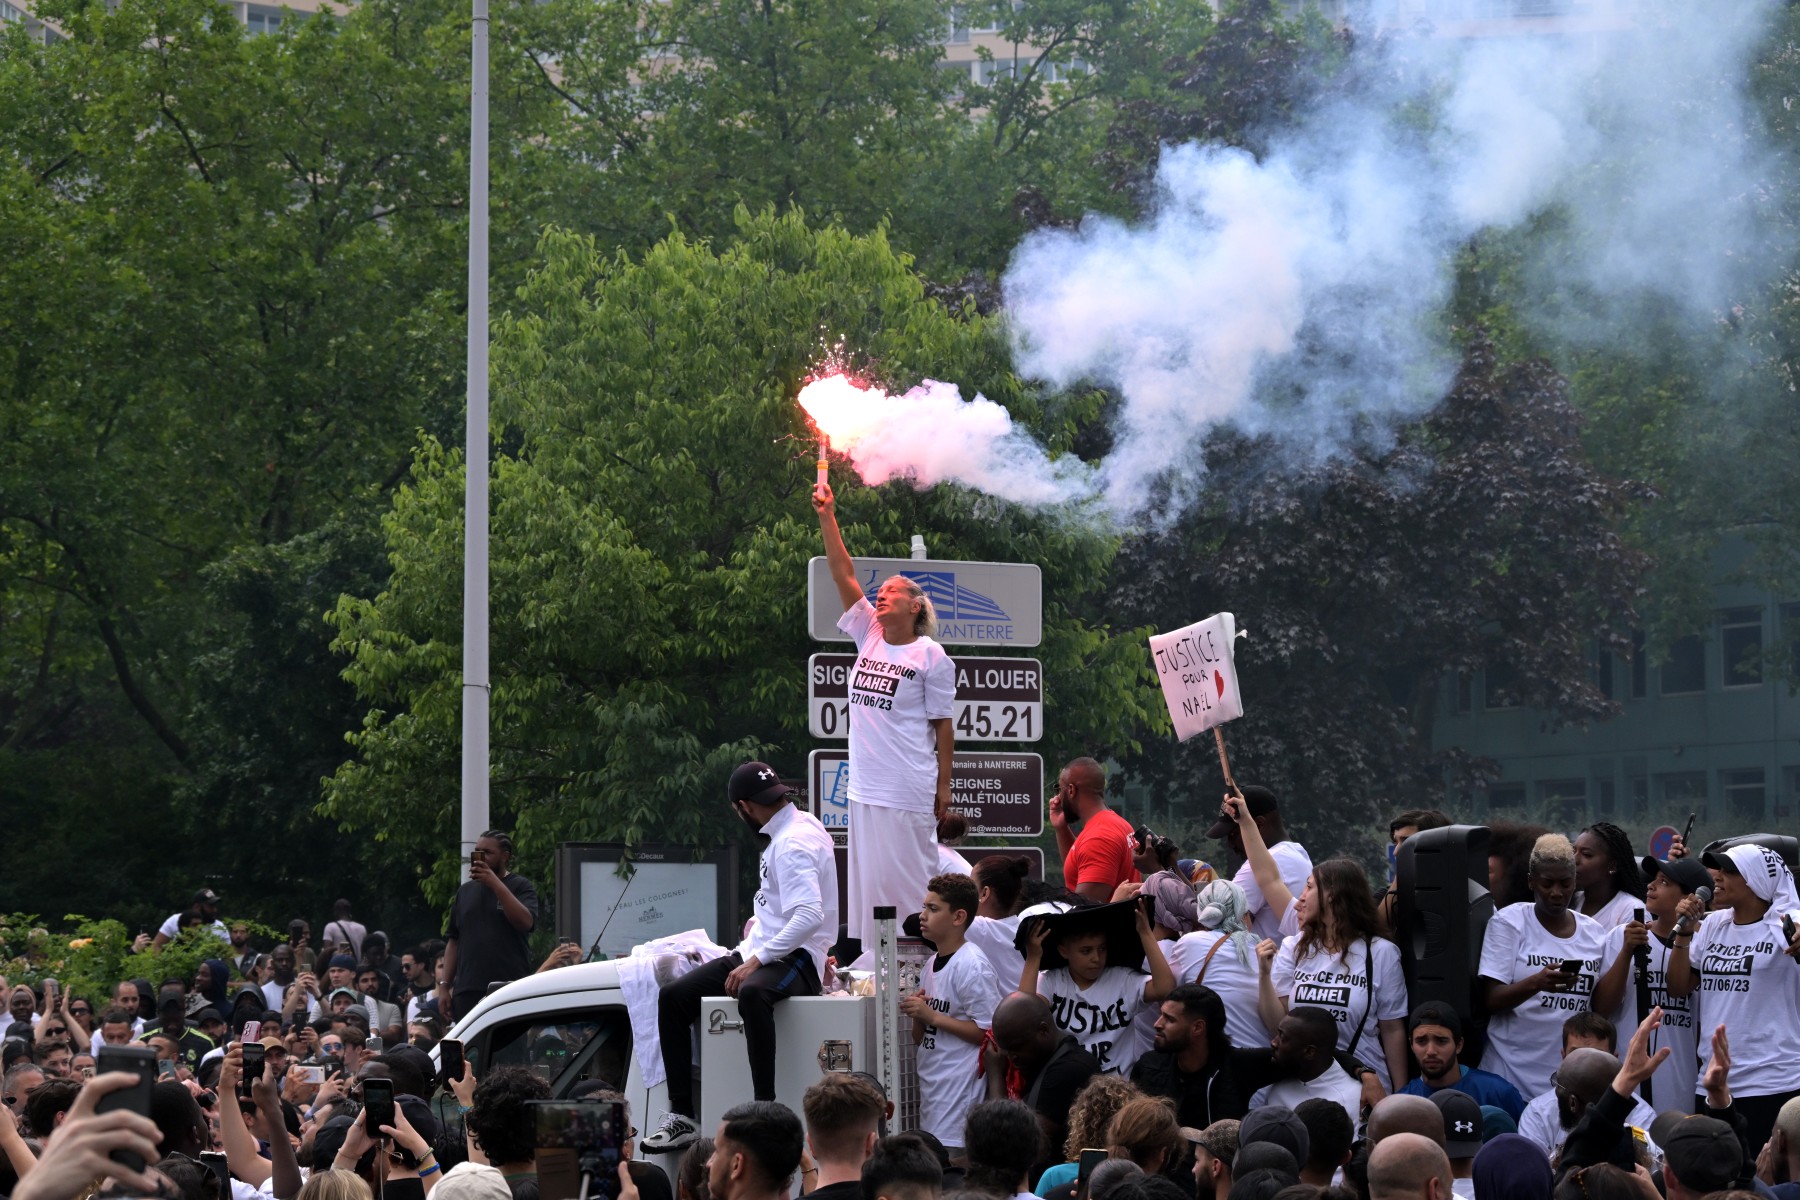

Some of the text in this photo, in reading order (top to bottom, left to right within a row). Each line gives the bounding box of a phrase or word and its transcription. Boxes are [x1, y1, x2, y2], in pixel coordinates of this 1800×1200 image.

[937, 624, 1014, 640] ANTERRE
[887, 663, 917, 681] POUR
[974, 669, 1038, 690] LOUER
[1181, 669, 1209, 691] POUR
[855, 673, 894, 694] NAHEL
[850, 692, 893, 711] 27/06/23
[978, 760, 983, 769] à
[984, 761, 1027, 770] NANTERRE
[949, 778, 1002, 790] SEIGNES
[951, 790, 1031, 805] NALÉTIQUES
[1703, 957, 1748, 973] NAHEL
[1334, 973, 1367, 989] POUR
[1702, 978, 1750, 993] 27/06/23
[1296, 986, 1346, 1004] NAHEL
